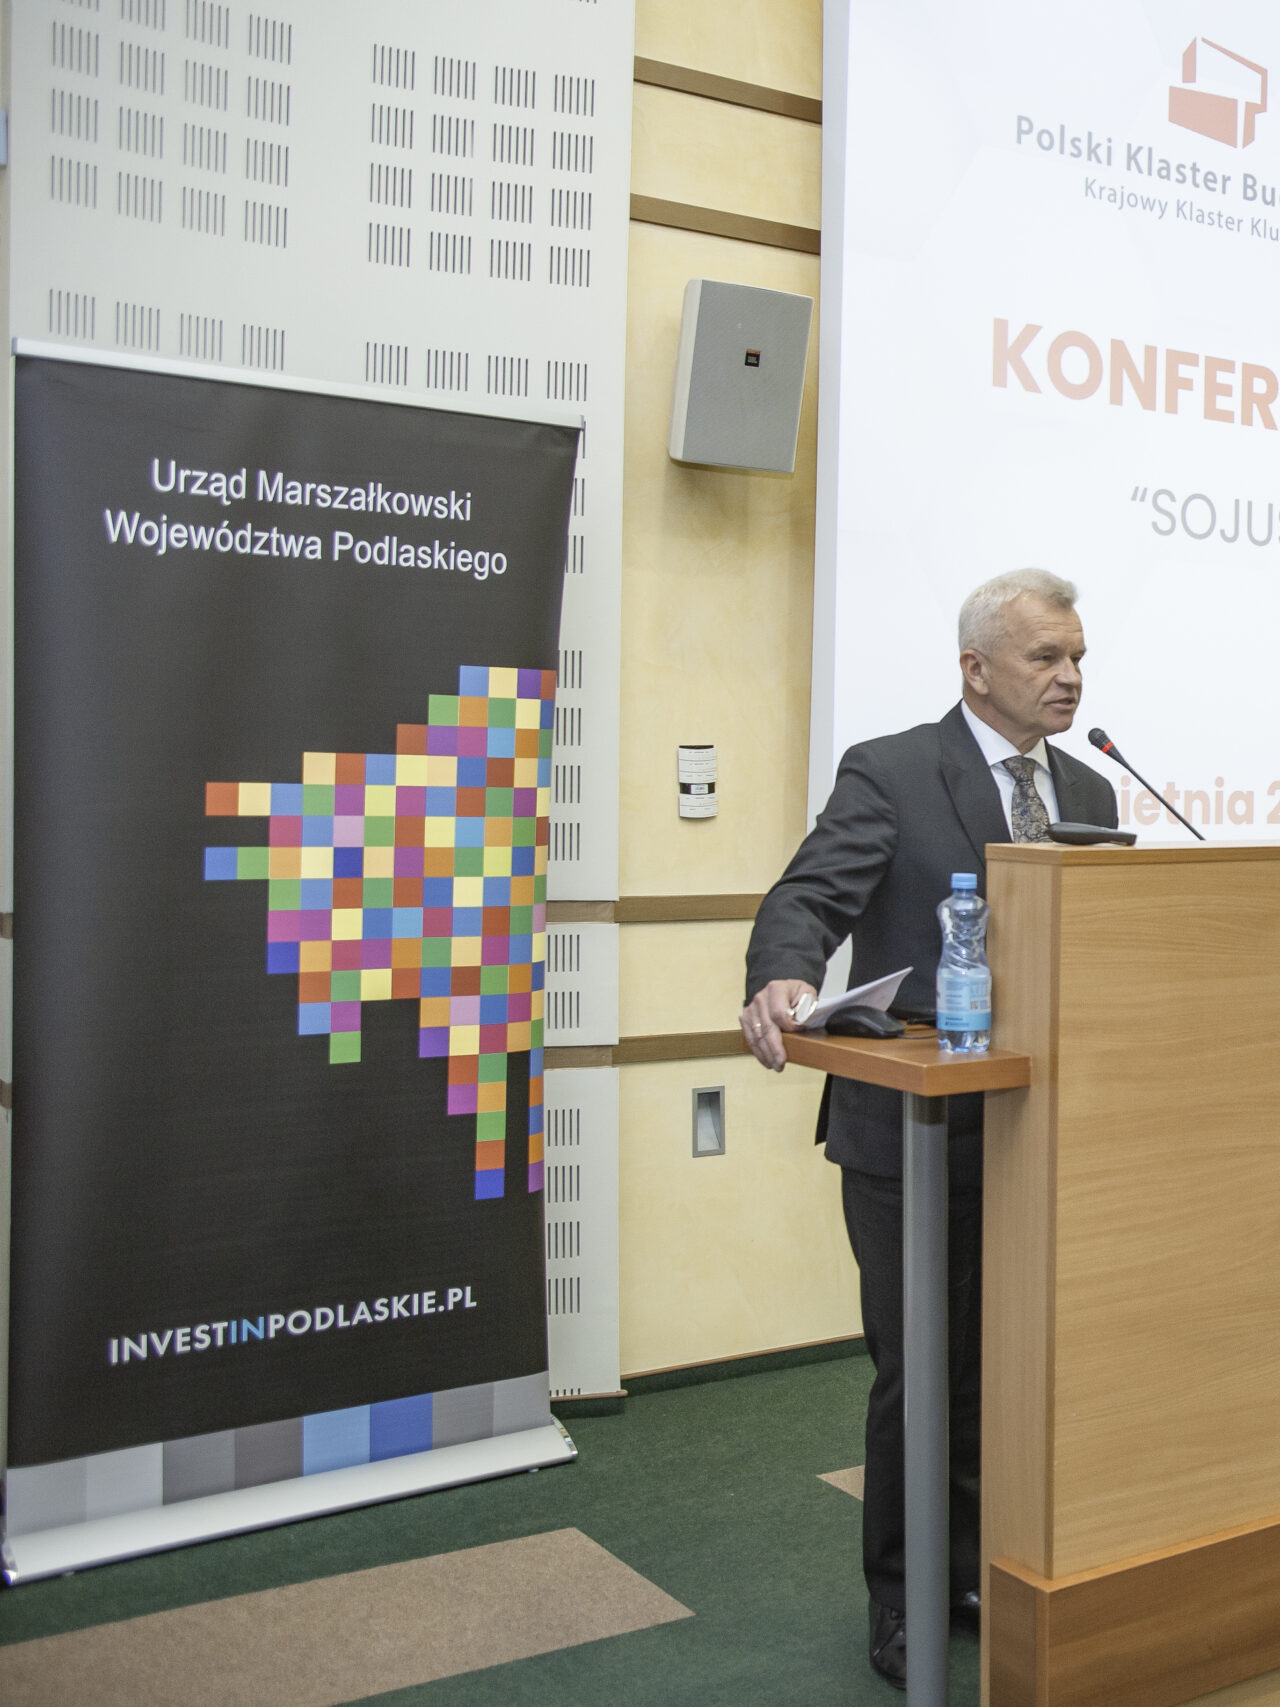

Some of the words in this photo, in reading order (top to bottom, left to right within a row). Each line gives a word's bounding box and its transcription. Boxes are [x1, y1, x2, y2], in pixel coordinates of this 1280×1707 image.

[1015, 114, 1113, 167] Polski
[1125, 142, 1232, 196] Klaster
[1084, 176, 1169, 220] Krajowy
[1176, 198, 1244, 233] Klaster
[152, 457, 247, 506] Urząd
[257, 469, 472, 522] Marszałkowski
[104, 508, 322, 560] Województwa
[333, 530, 508, 581] Podlaskiego
[1115, 775, 1254, 825] ietnia
[110, 1285, 478, 1365] INVESTINPODLASKIE.PL
